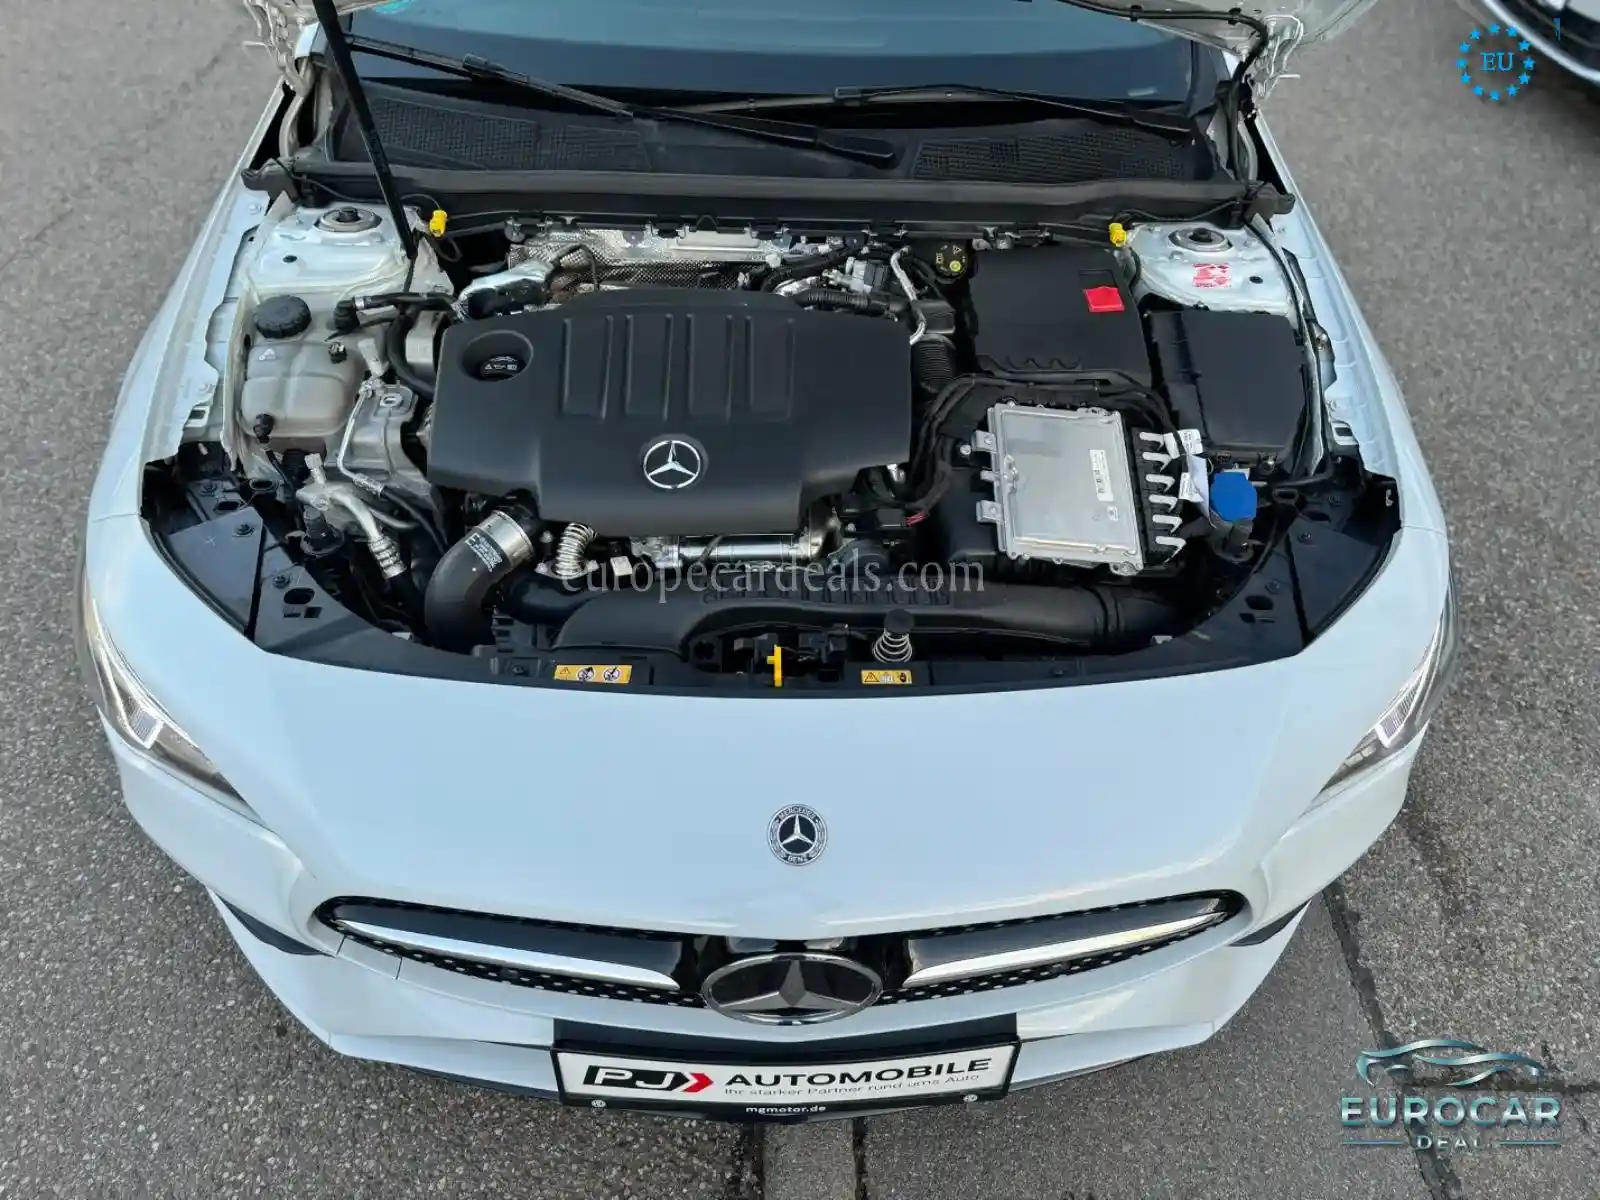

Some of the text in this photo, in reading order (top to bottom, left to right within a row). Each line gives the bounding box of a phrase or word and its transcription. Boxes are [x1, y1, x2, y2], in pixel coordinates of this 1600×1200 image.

[725, 1057, 992, 1087] AUTOMOBILE
[808, 1086, 863, 1095] Partner
[945, 1074, 979, 1084] Auto
[745, 1105, 827, 1114] mgmotor.de
